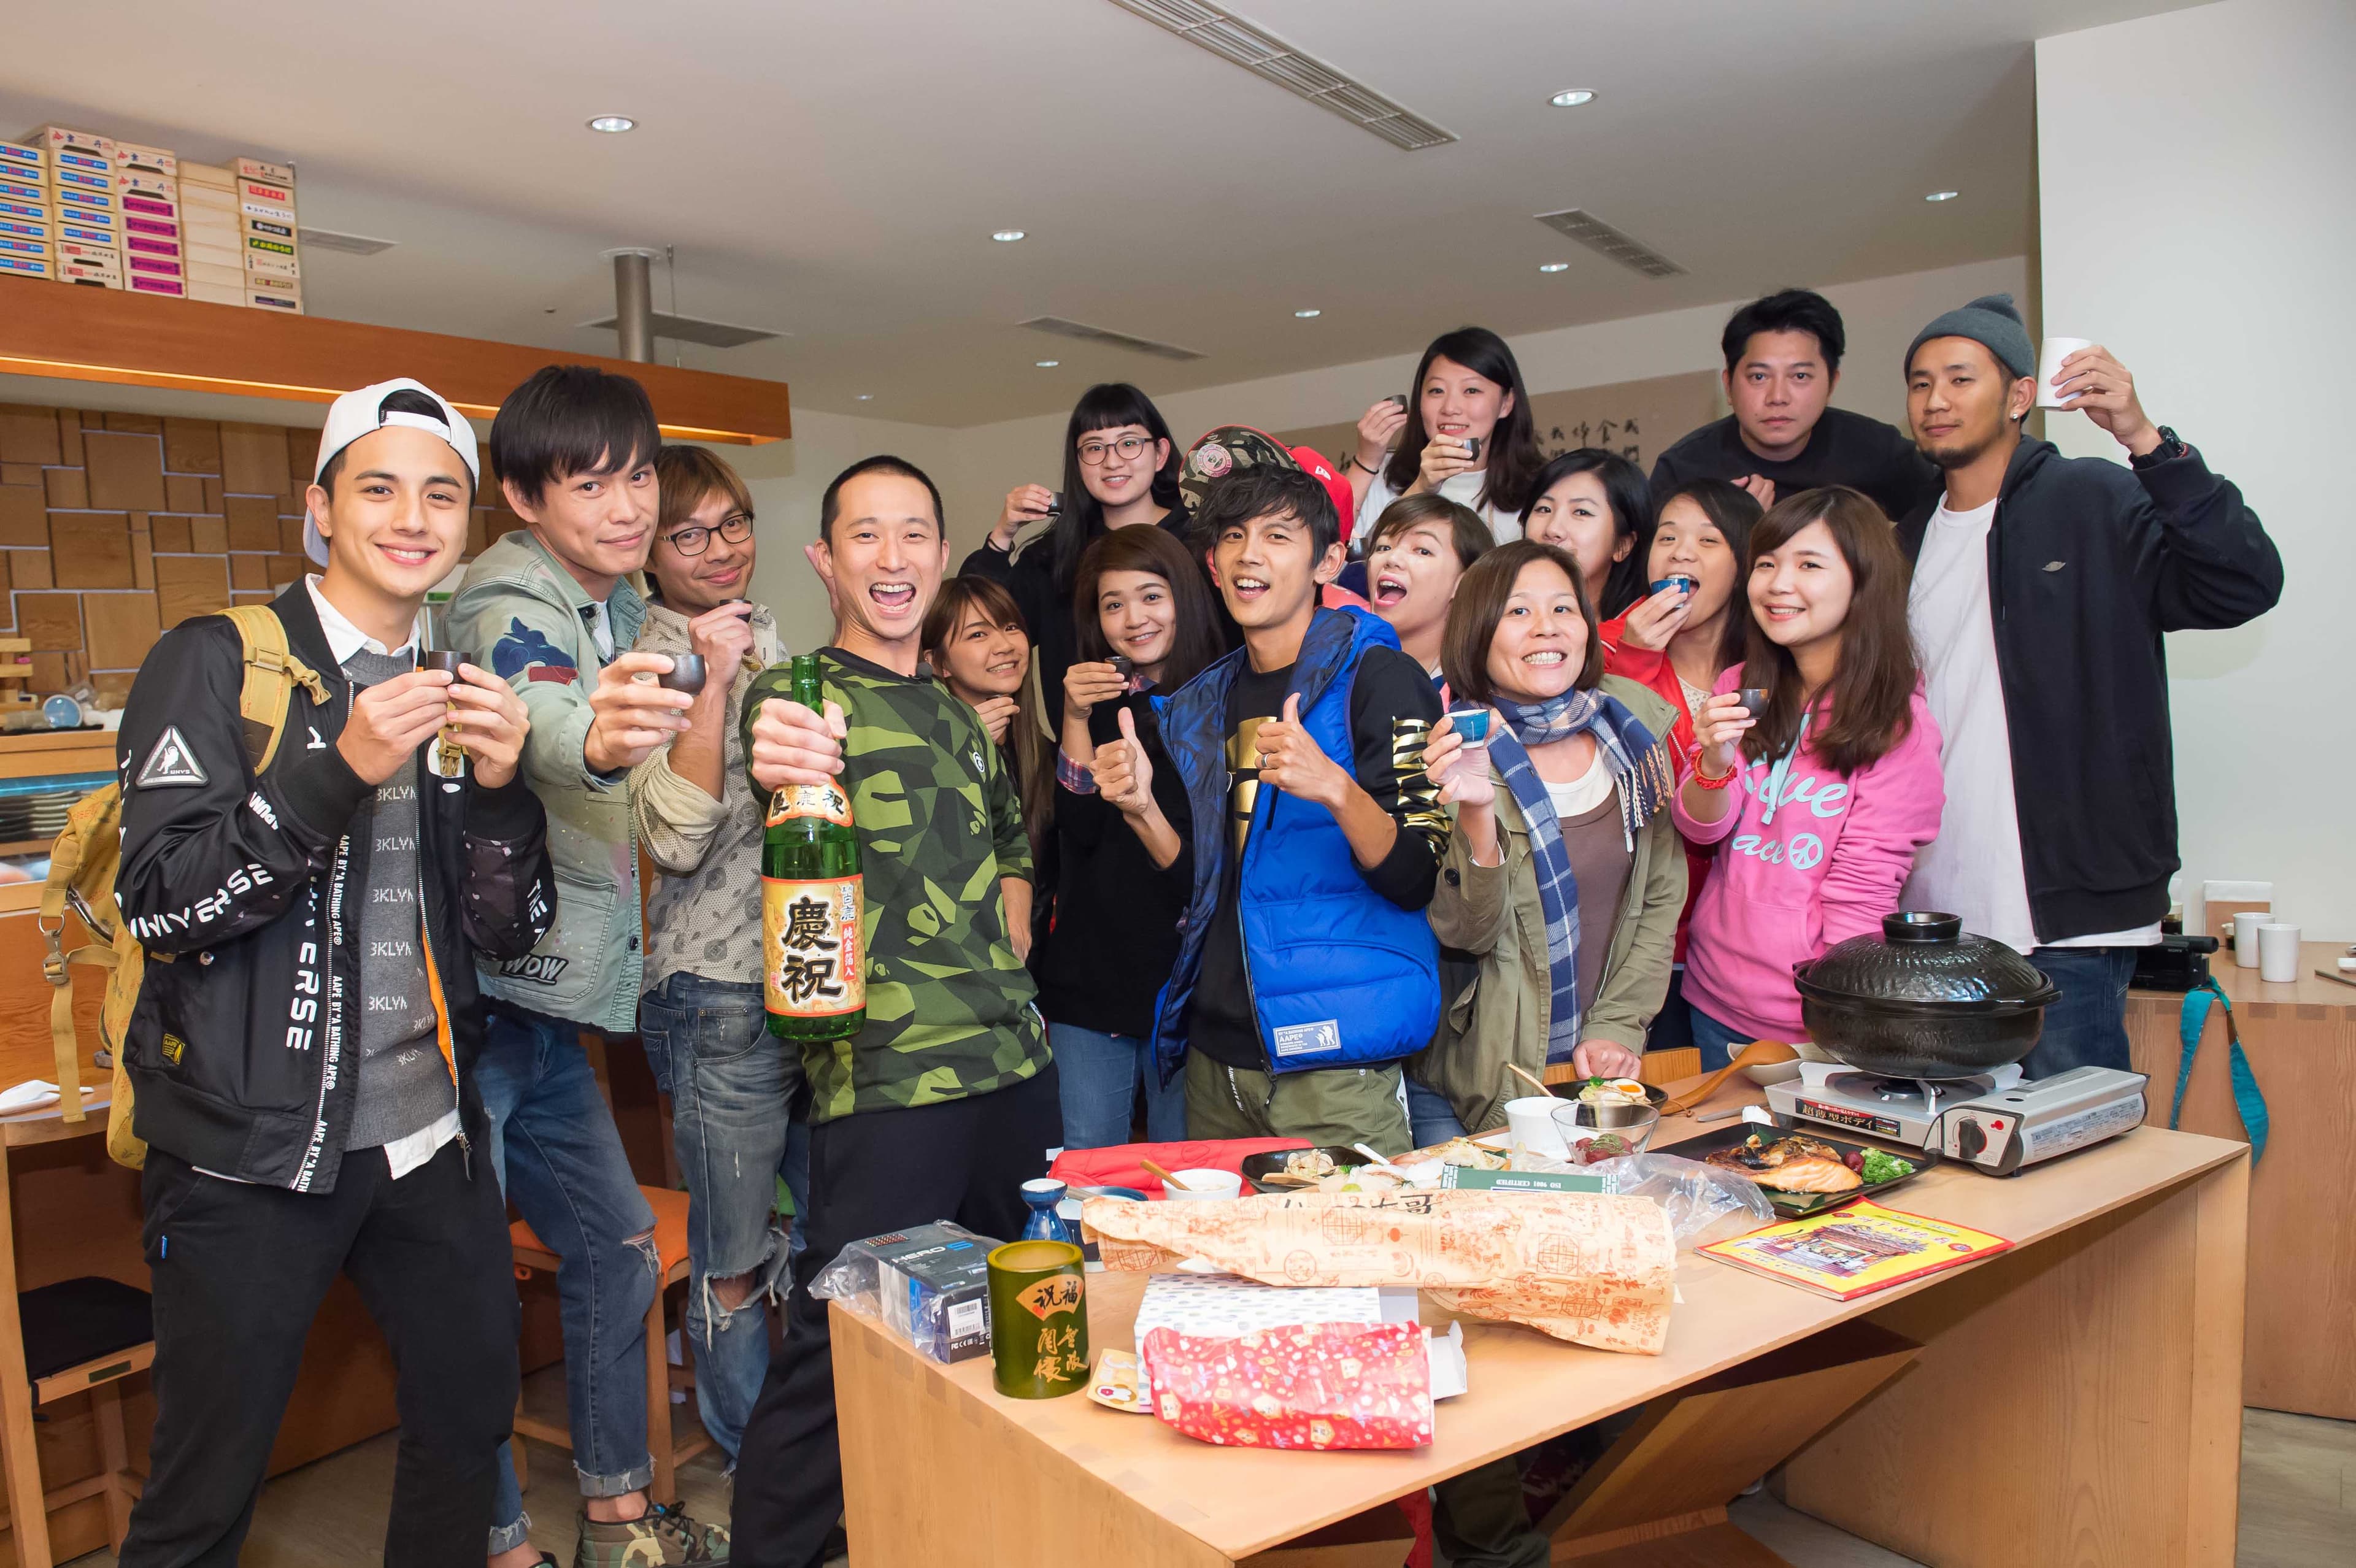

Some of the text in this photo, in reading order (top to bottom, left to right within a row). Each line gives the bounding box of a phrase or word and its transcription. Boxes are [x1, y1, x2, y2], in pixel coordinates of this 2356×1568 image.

[339, 835, 350, 856] AAPE
[337, 859, 348, 870] BY
[331, 883, 344, 919] BATHING
[781, 894, 844, 1004] 慶祝
[843, 926, 855, 977] 純金箔入
[504, 955, 566, 980] WOW
[287, 940, 320, 1051] ERSE
[332, 975, 342, 998] AAPE
[332, 1002, 342, 1012] BY
[328, 1026, 341, 1063] BATHING
[1802, 1104, 1873, 1129] 超薄型ボディ
[313, 1120, 328, 1143] AAPE
[309, 1146, 321, 1158] BY
[891, 1246, 946, 1264] HERO
[1033, 1280, 1078, 1310] 祝福
